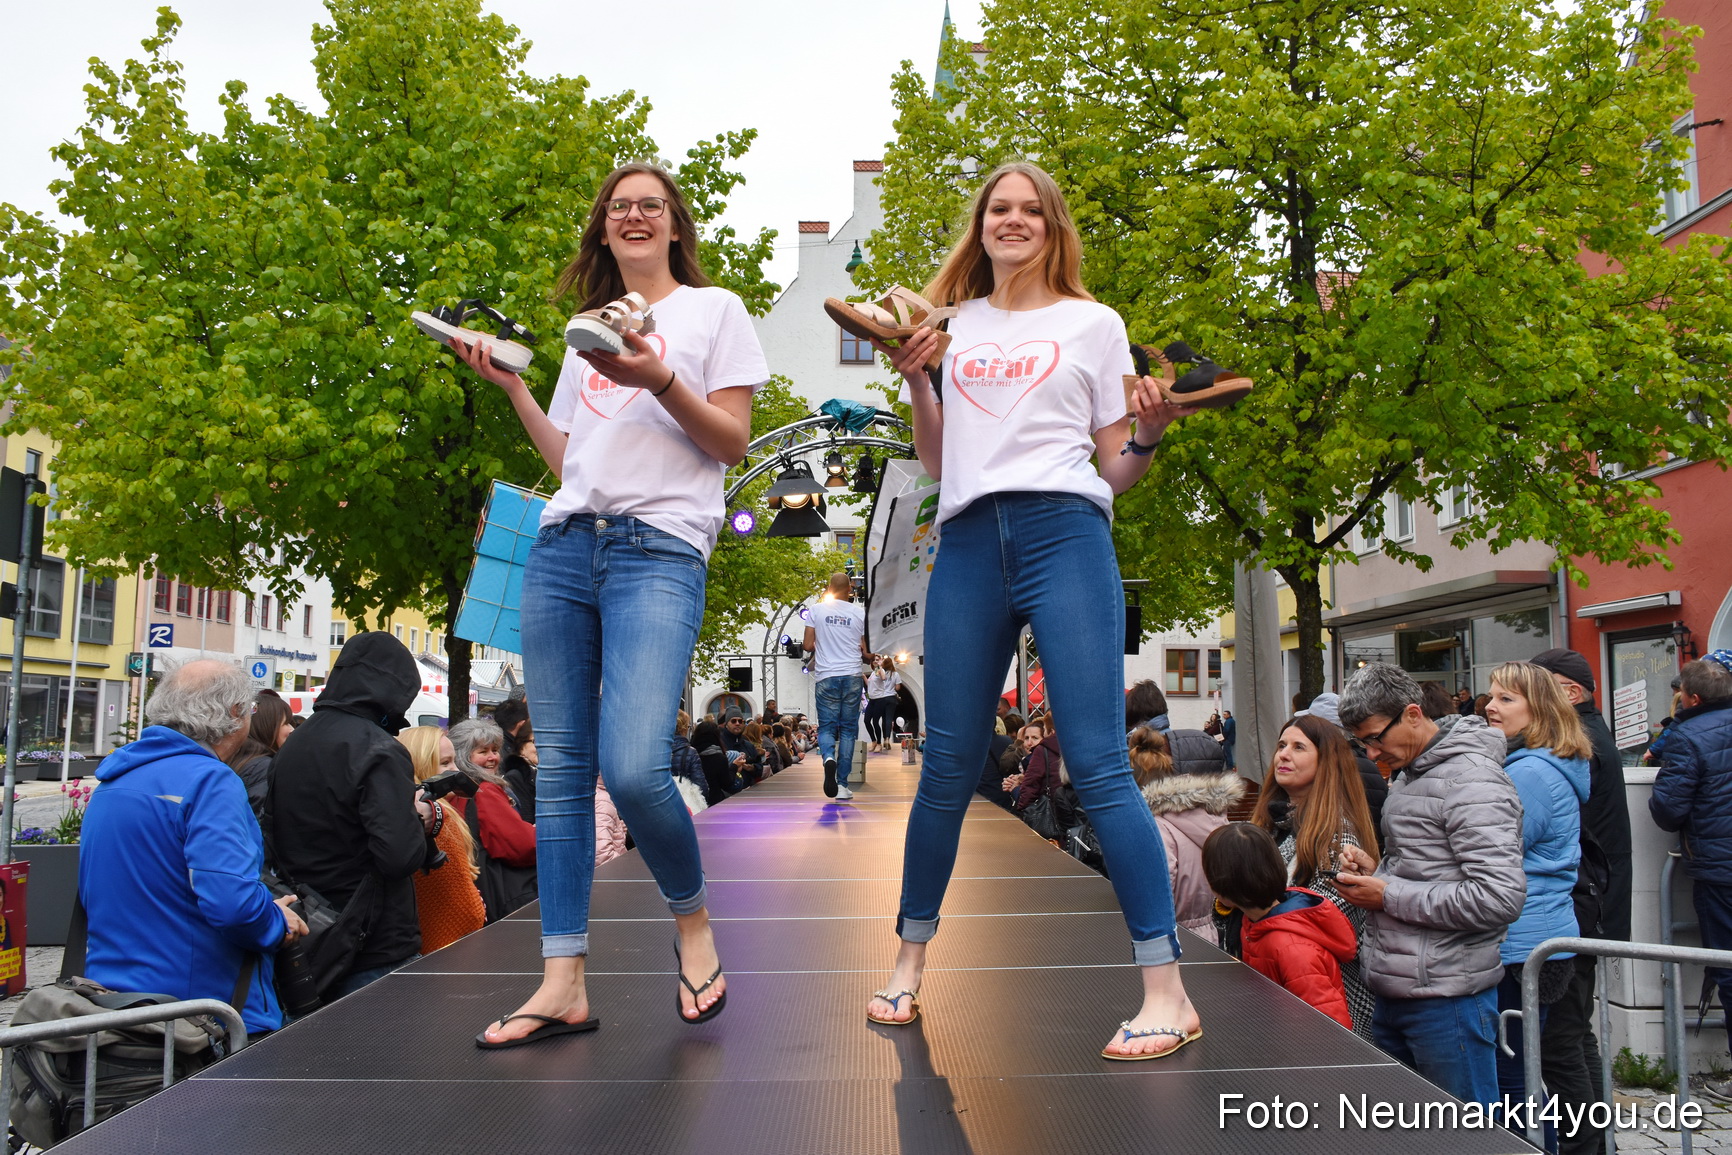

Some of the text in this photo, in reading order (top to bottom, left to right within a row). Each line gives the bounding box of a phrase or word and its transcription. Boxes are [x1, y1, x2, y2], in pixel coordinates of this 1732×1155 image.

[961, 379, 993, 388] Service
[1013, 377, 1034, 387] Herz
[587, 388, 615, 401] Service
